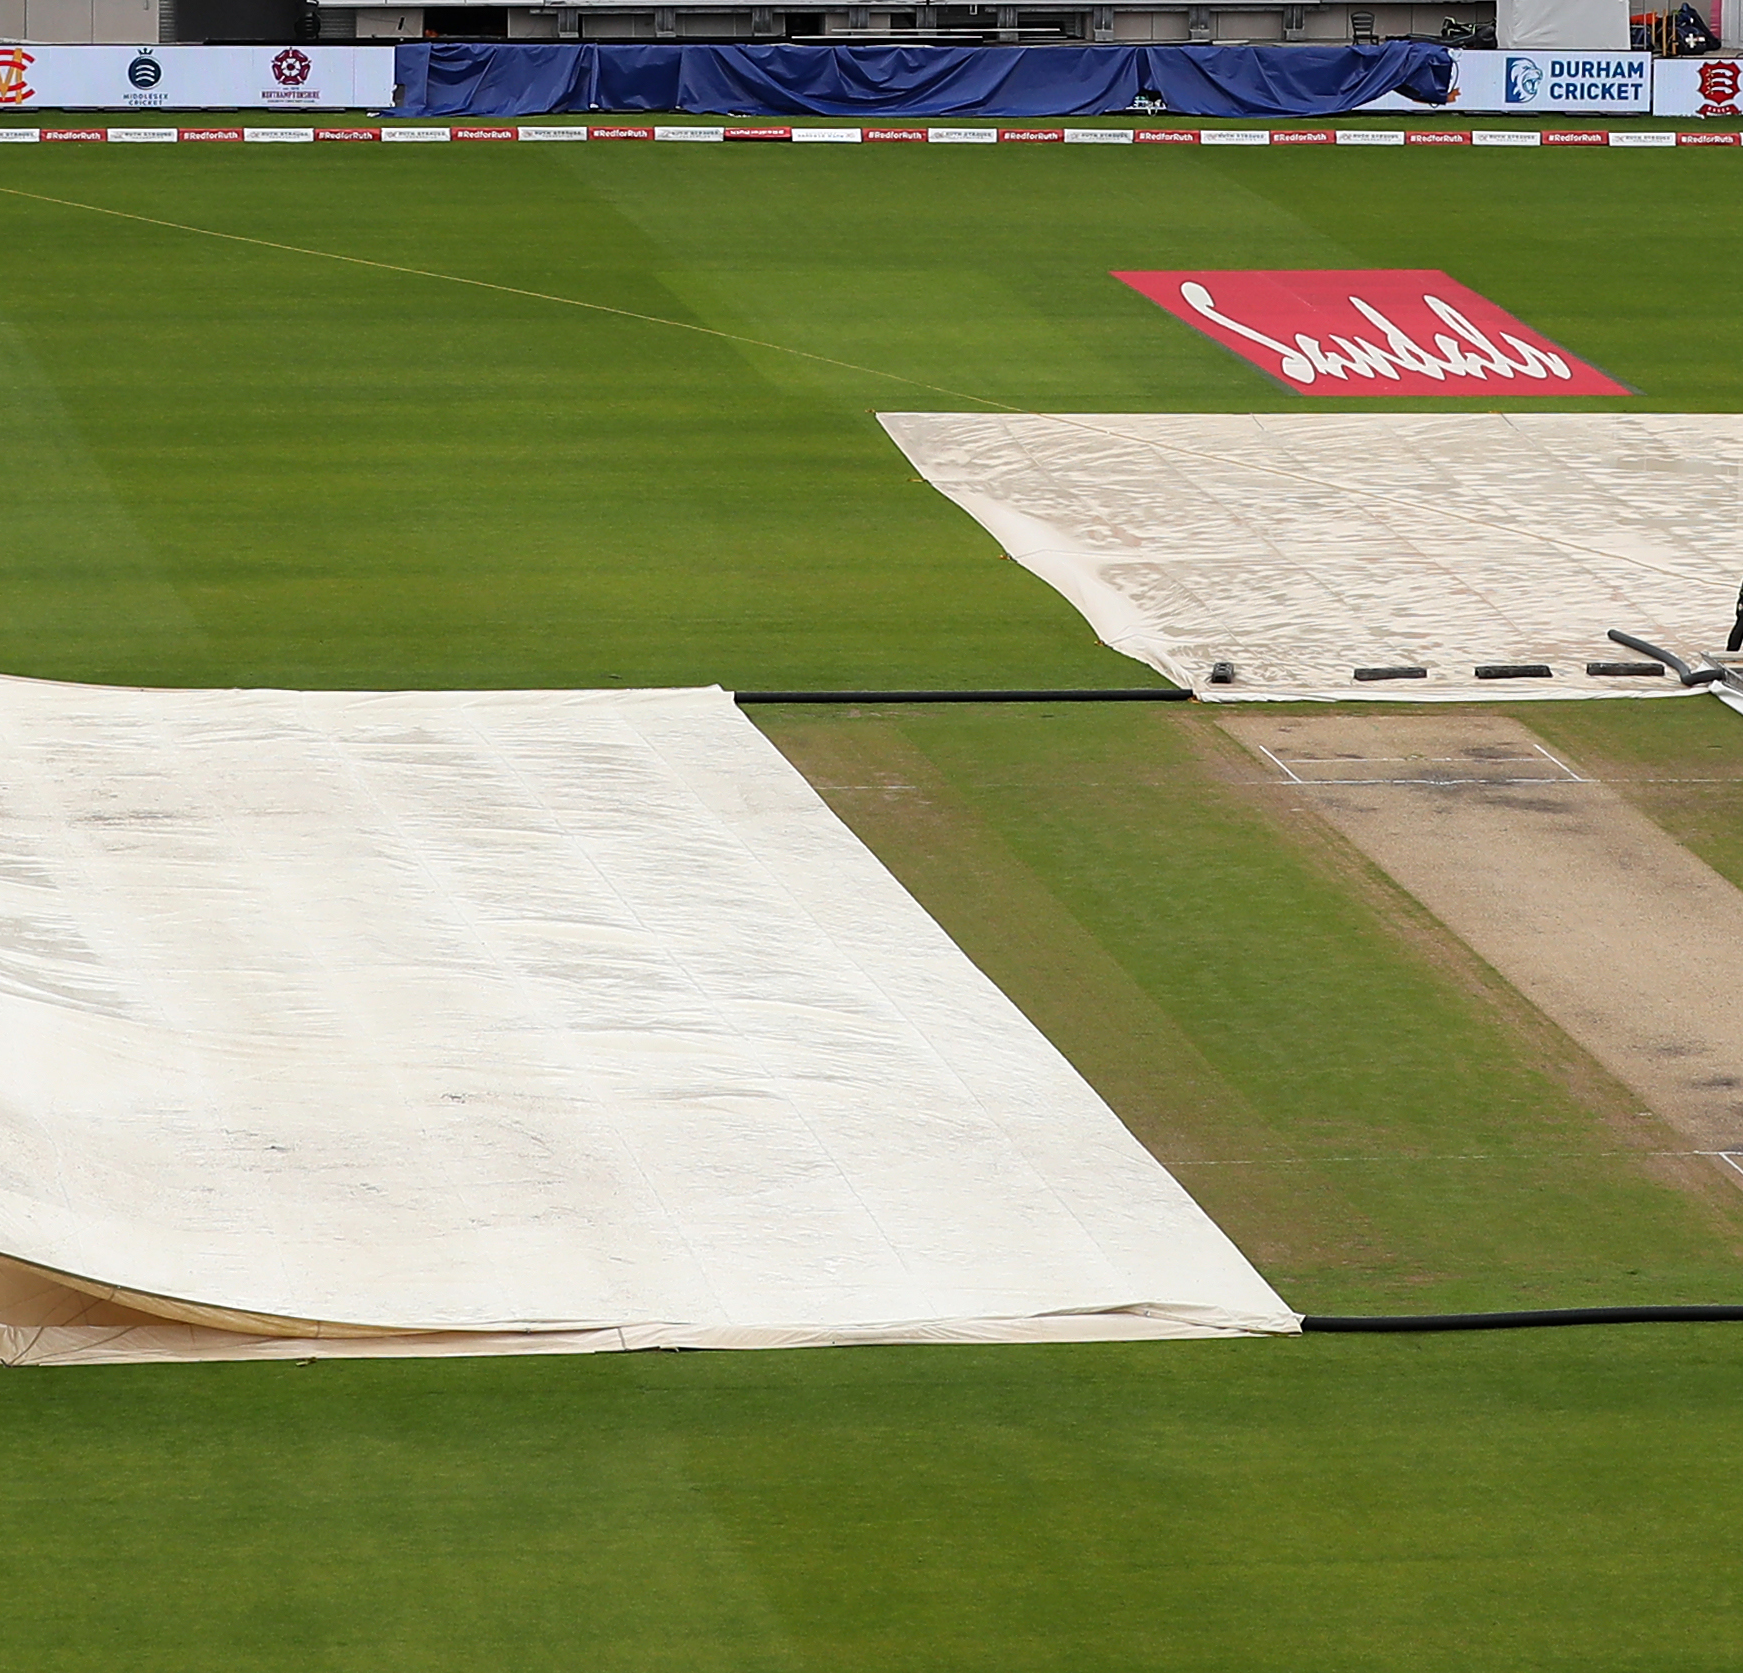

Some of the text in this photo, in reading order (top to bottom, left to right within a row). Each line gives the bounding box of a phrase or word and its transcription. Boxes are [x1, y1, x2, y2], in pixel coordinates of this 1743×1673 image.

[1550, 60, 1644, 78] DURHAM
[1550, 82, 1643, 101] CRICKET
[46, 132, 101, 141] #RedforRuth
[184, 132, 238, 141] #RedforRuth
[1548, 133, 1602, 143] #RedforRuth
